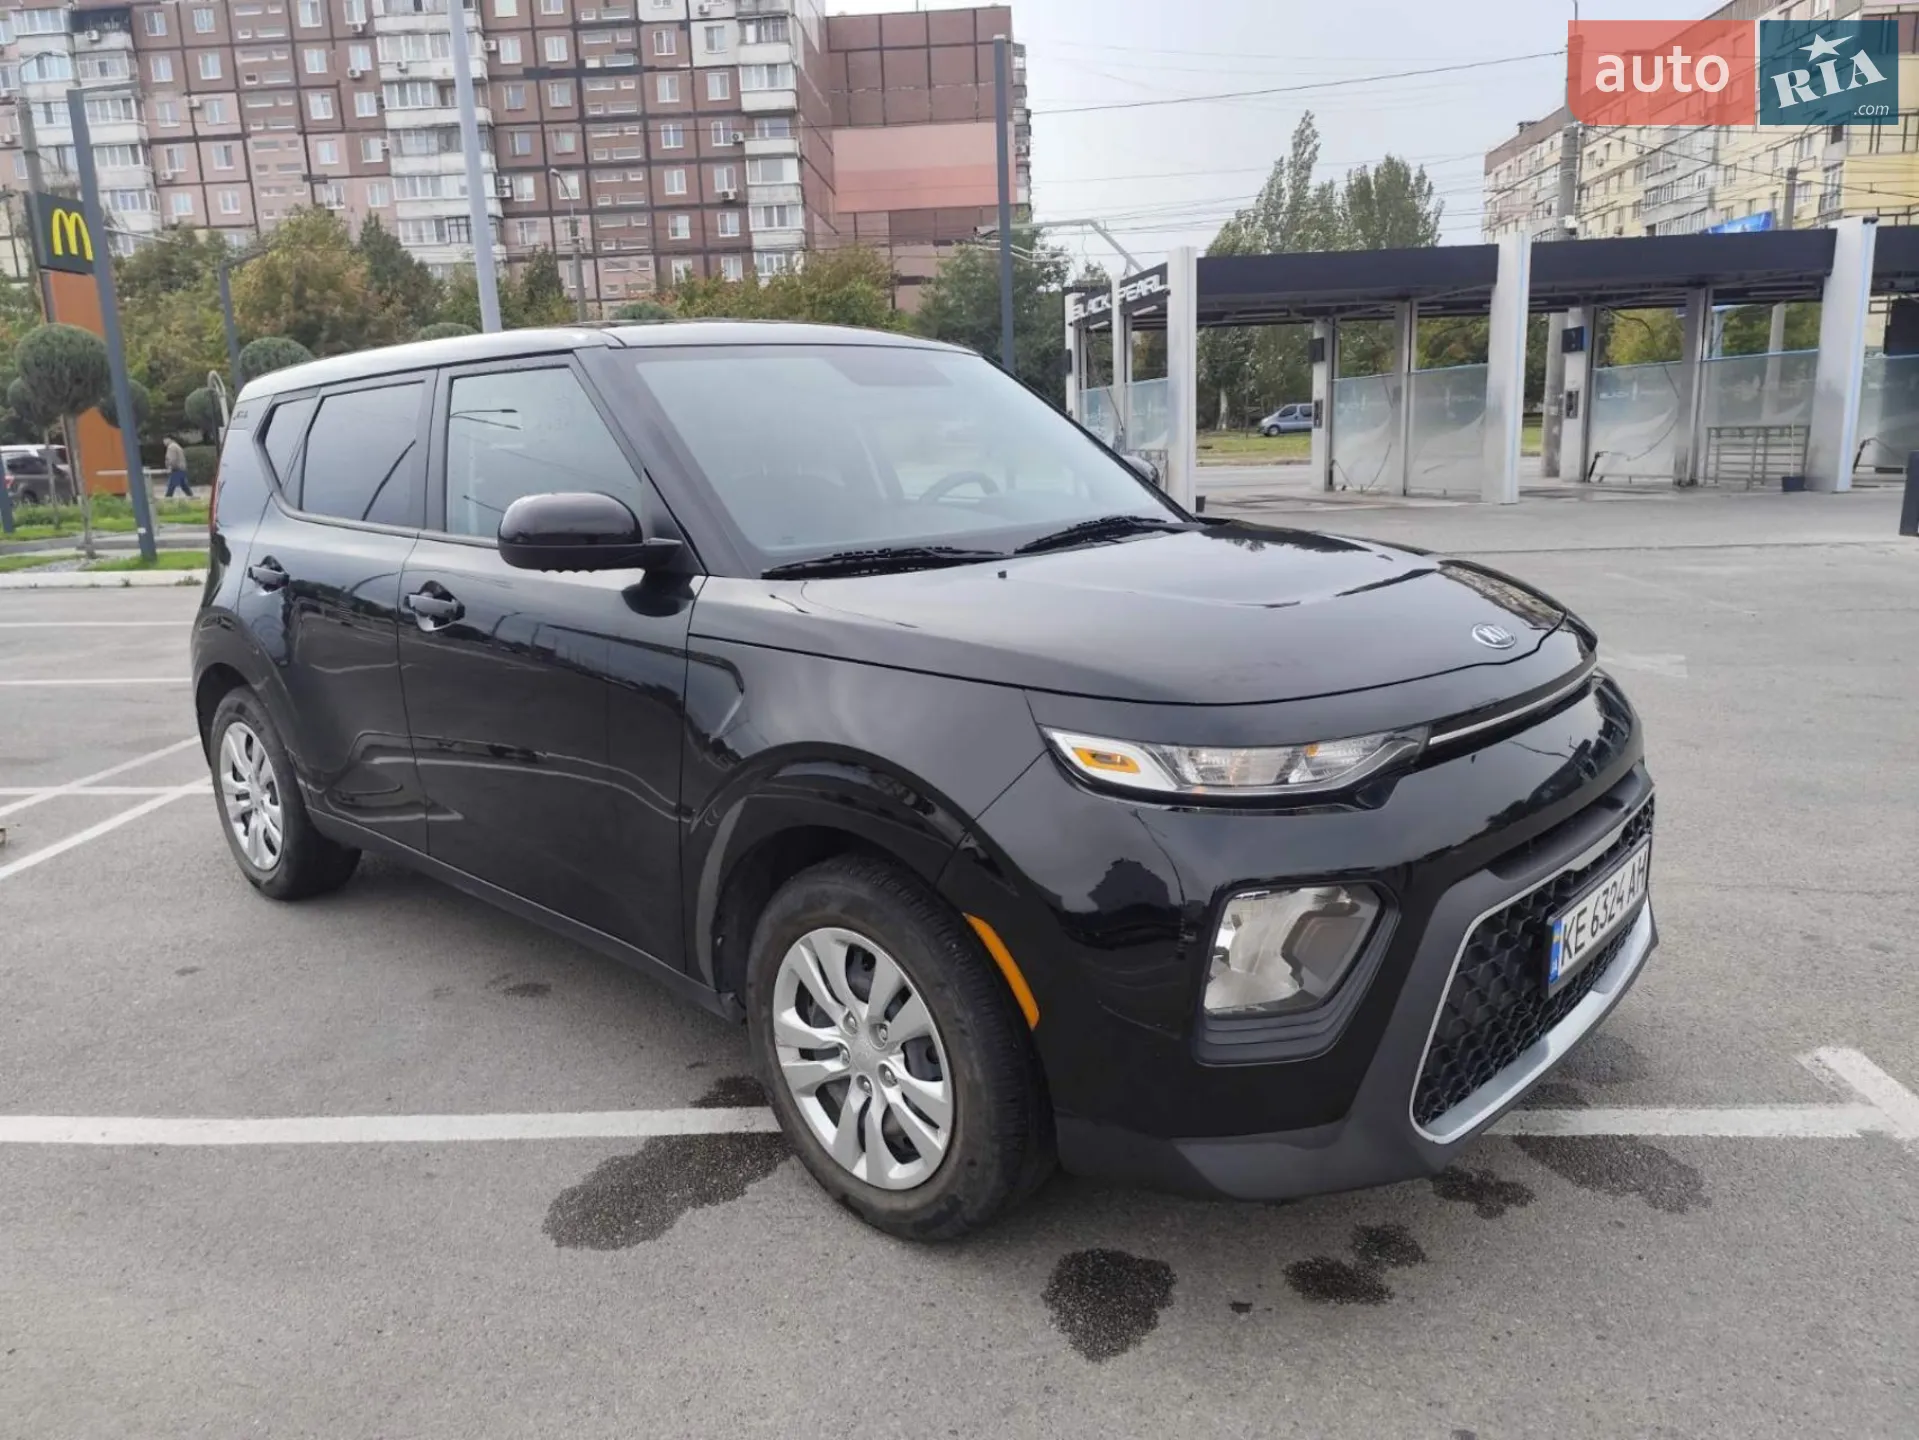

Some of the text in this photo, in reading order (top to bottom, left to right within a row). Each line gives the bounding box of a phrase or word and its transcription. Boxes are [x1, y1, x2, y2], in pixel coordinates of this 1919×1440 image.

[1072, 274, 1168, 319] BLACK PEARL
[1561, 850, 1648, 966] KE 6324 AH
